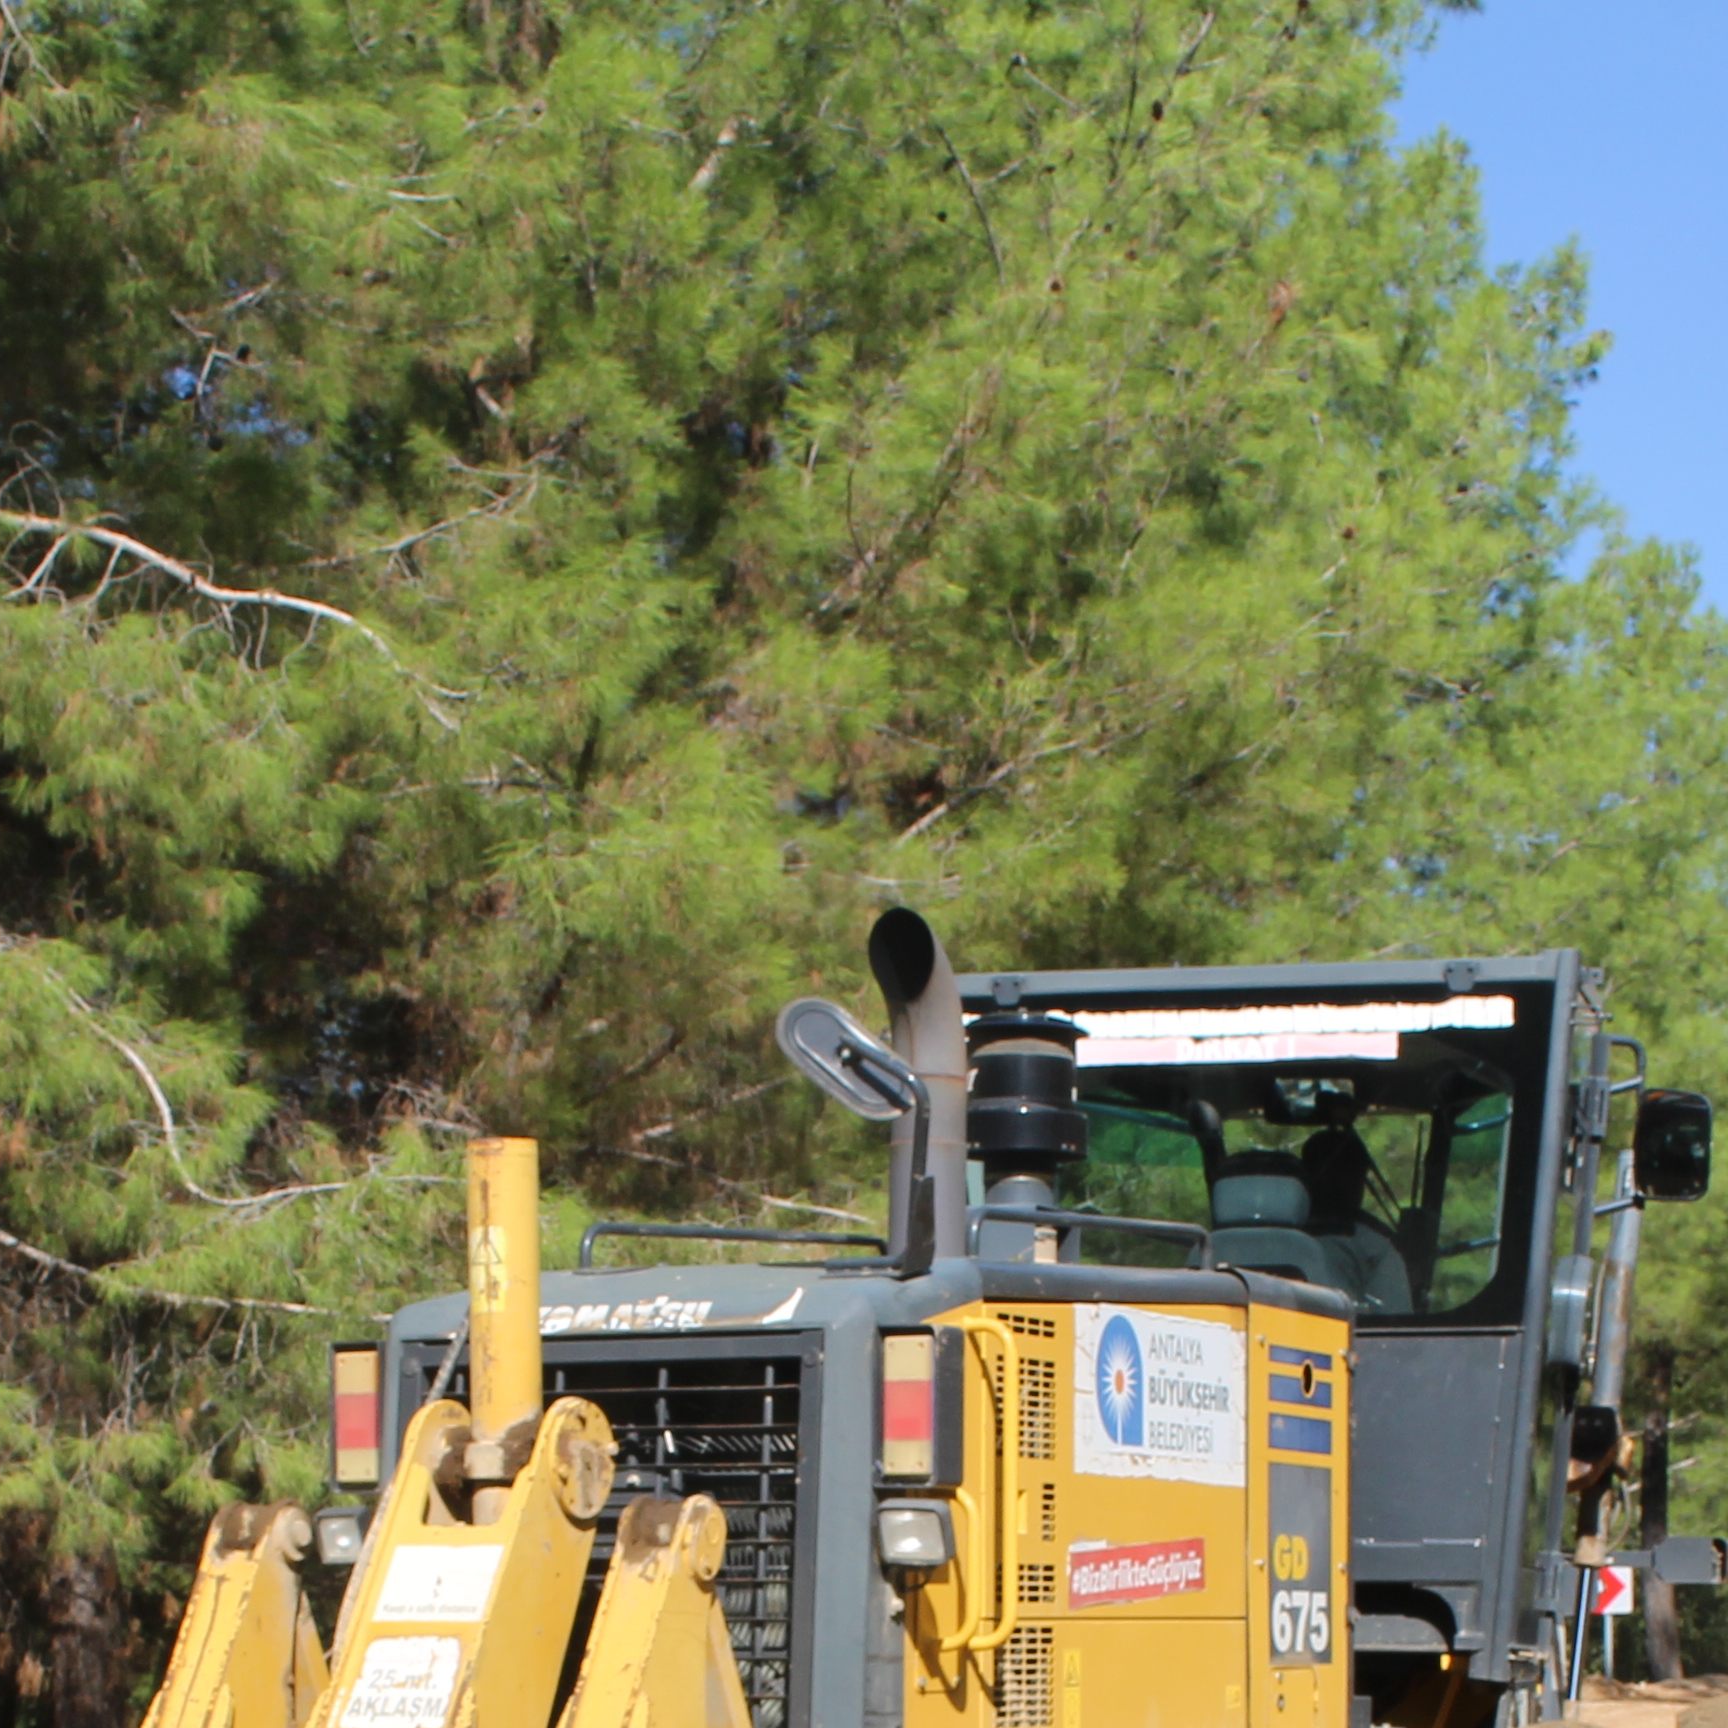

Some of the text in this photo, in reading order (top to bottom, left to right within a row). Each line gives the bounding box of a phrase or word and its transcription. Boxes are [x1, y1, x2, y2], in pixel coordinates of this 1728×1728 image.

[1149, 1332, 1204, 1366] ANTALYA
[1148, 1368, 1230, 1416] BÜYÜKŞEHİR
[1149, 1417, 1214, 1454] BELEDİYESİ
[1072, 1550, 1202, 1596] #BizBirlikteGüçlüyüz
[1273, 1533, 1309, 1581] GD
[1272, 1589, 1330, 1653] 675
[368, 1668, 397, 1690] 25
